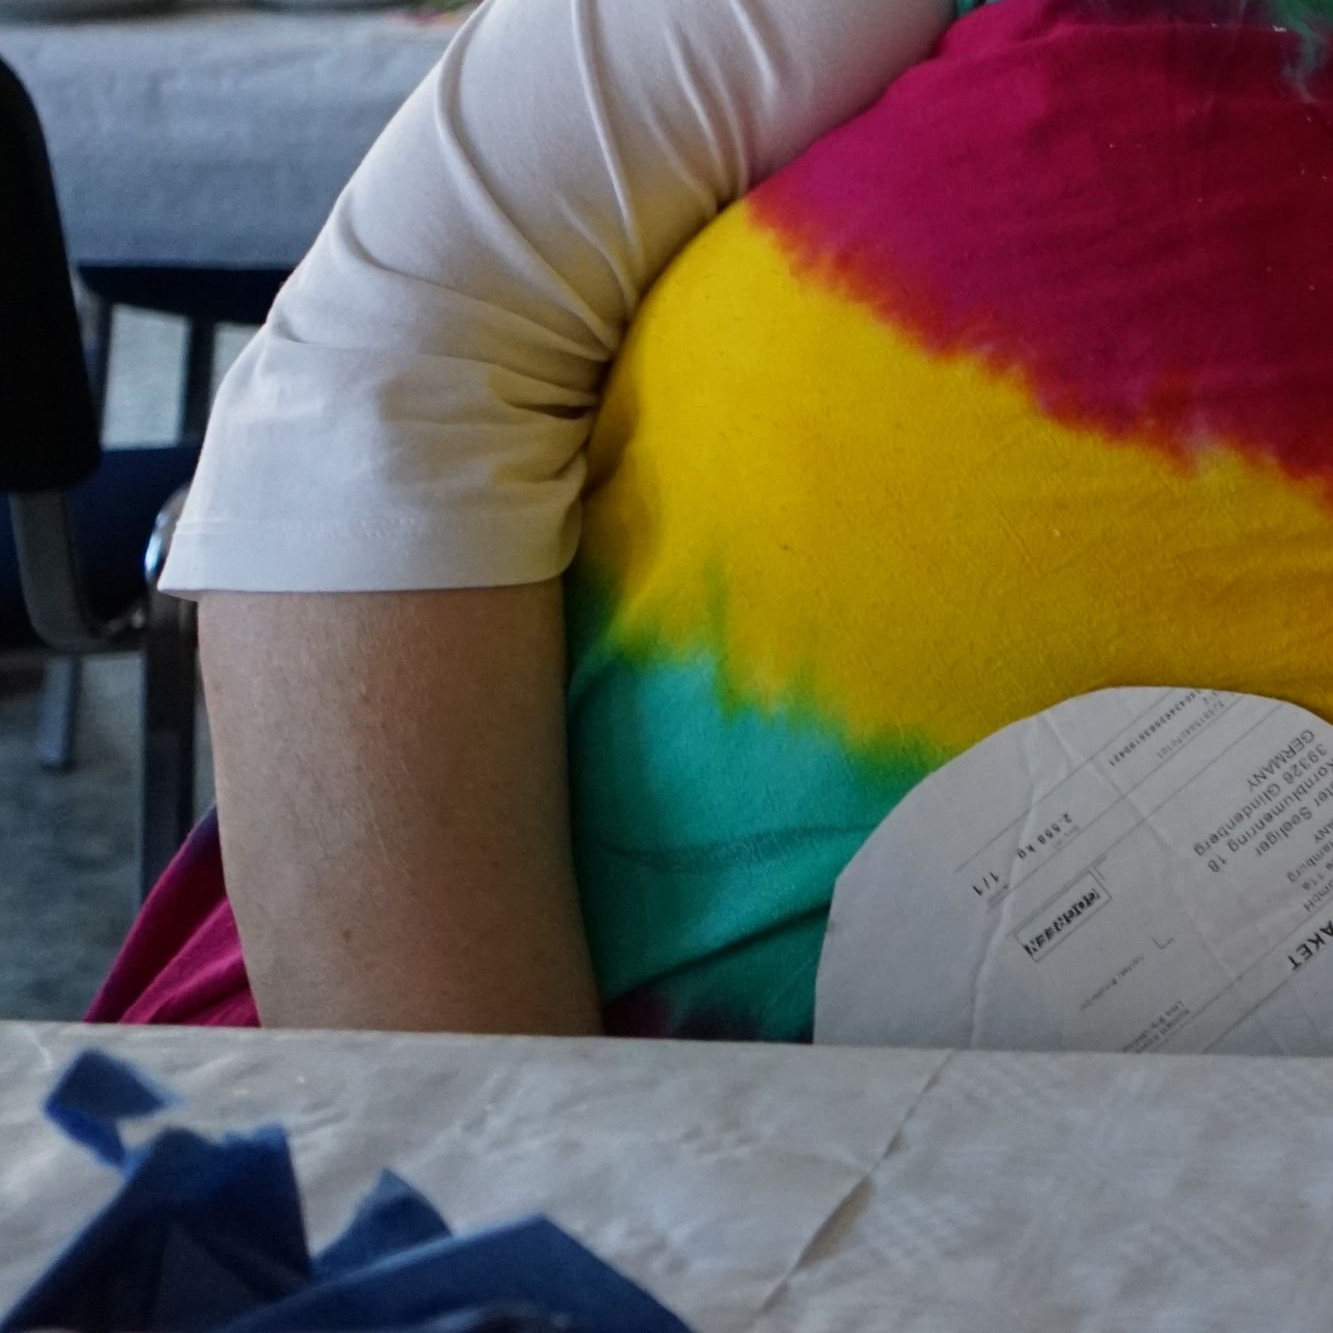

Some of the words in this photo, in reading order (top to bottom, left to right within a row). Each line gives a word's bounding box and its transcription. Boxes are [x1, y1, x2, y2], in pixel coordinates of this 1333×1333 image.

[1246, 729, 1315, 792] GERMANY
[1192, 783, 1281, 857] Glindenberg
[1255, 806, 1313, 857] Seeliger
